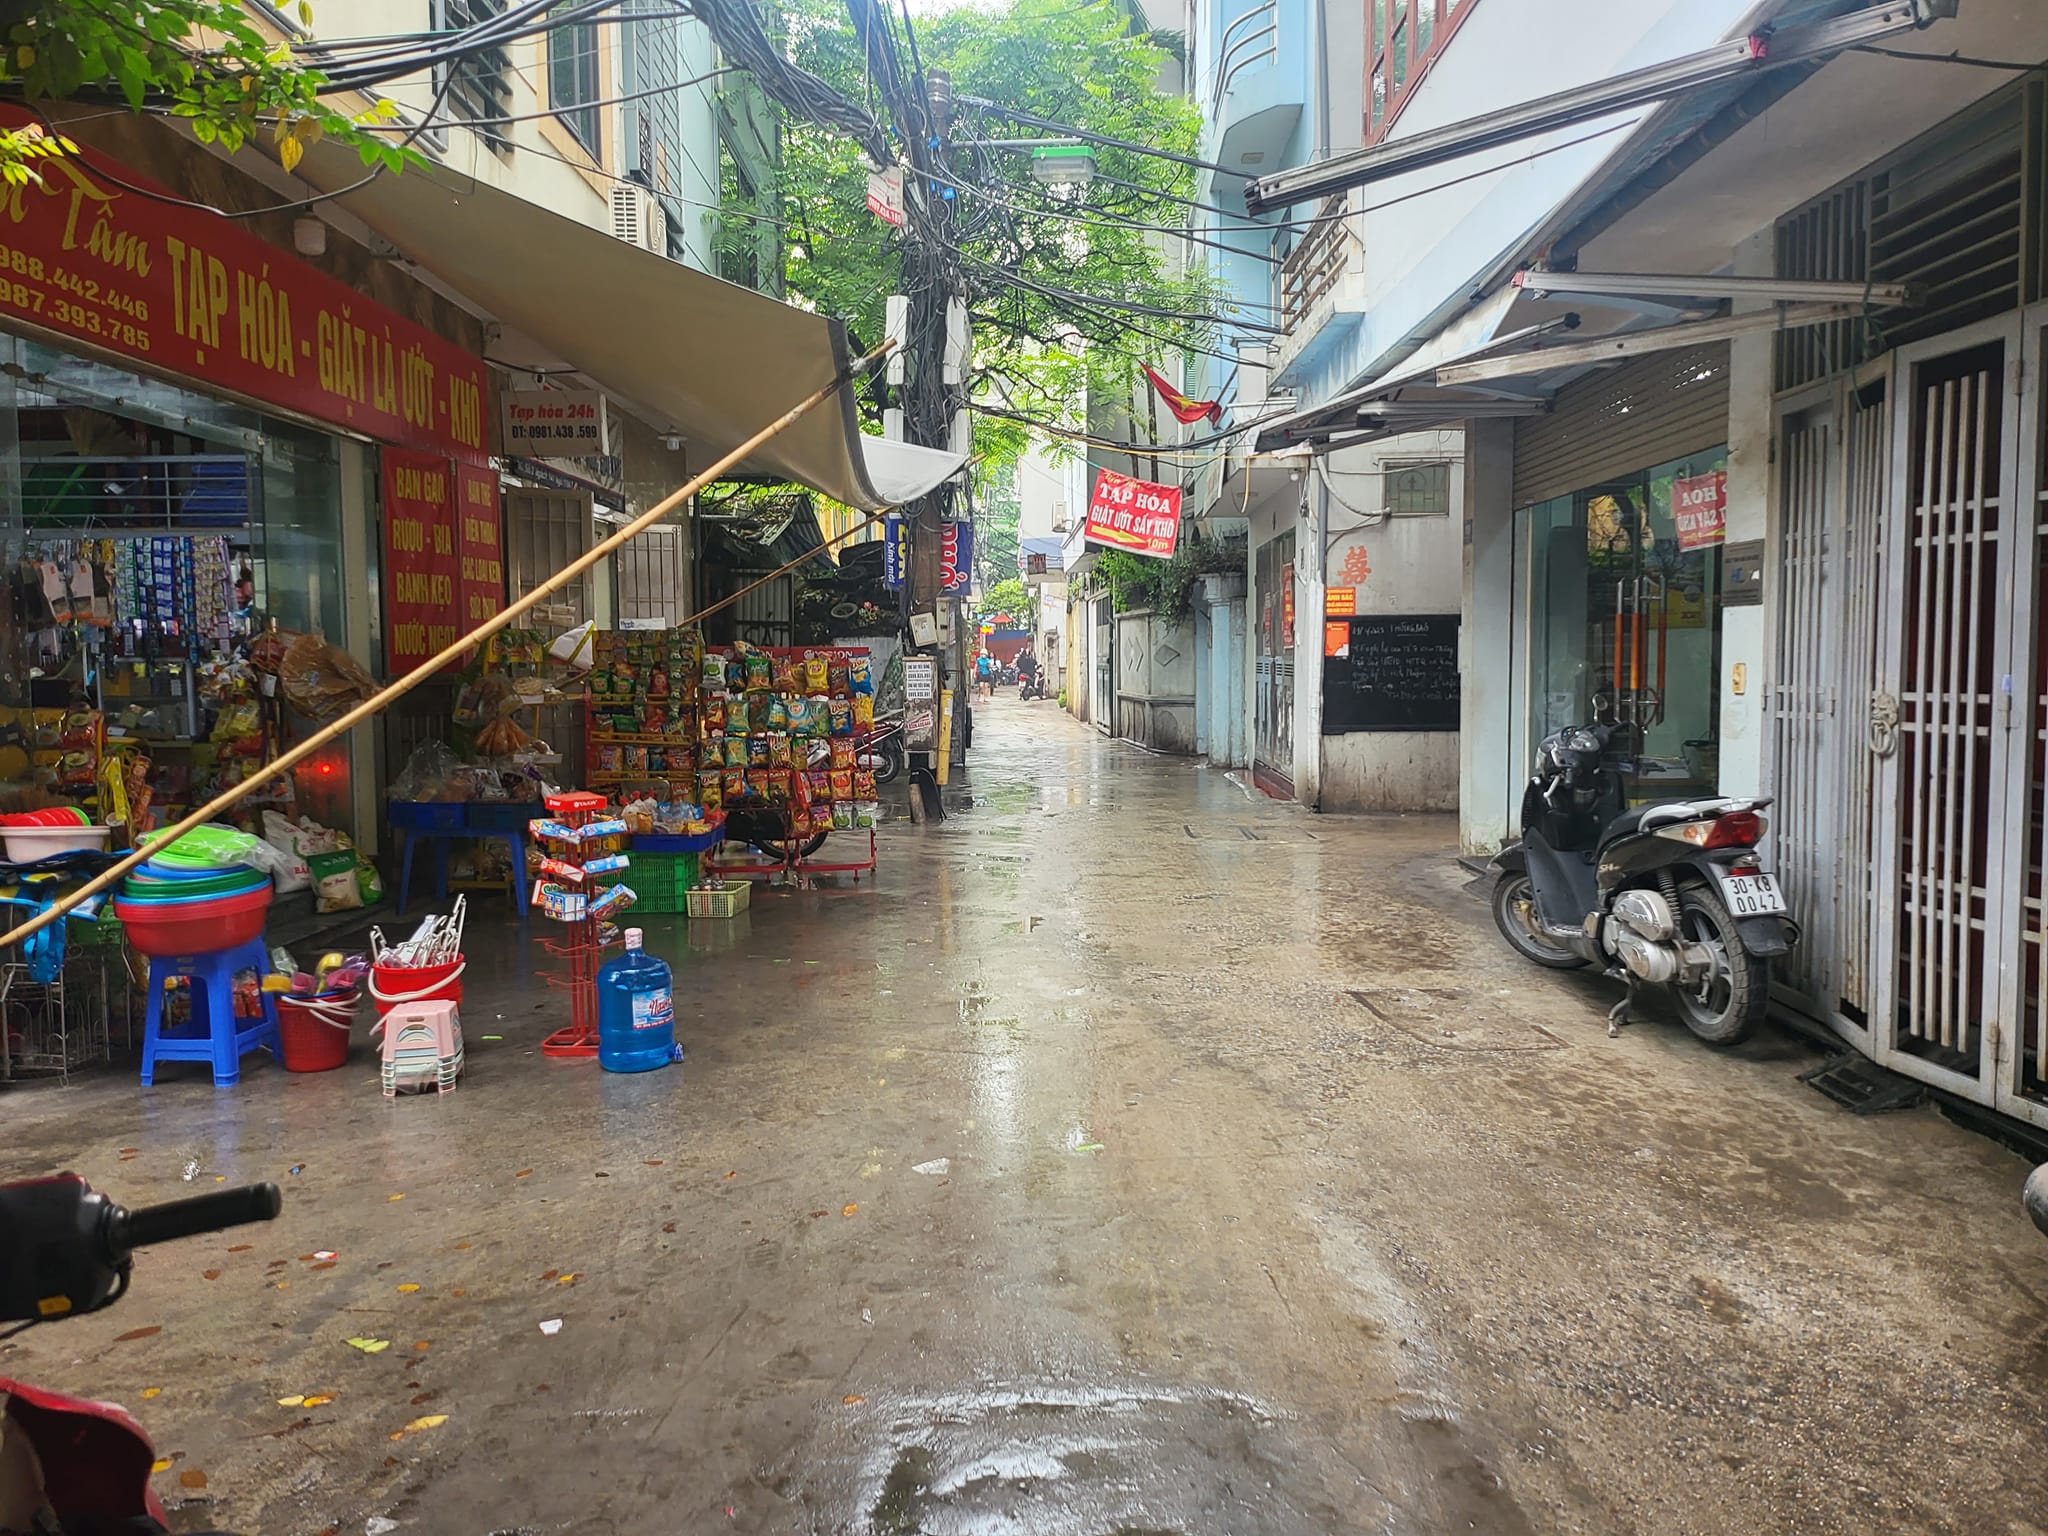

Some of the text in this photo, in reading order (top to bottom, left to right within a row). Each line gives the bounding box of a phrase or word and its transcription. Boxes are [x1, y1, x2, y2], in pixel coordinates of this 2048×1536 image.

[38, 156, 152, 277] Tâm
[167, 236, 229, 365] TẠP
[238, 263, 295, 378] HÓA
[317, 304, 368, 417] GIẶT
[371, 324, 398, 416] LÀ
[449, 371, 481, 449] KHÔ
[509, 403, 595, 422] Tạp hóa 24h
[1100, 483, 1171, 513] TẠP HÓA
[1091, 504, 1175, 538] GIẶT ƯỚT SẤY KHÔ
[433, 524, 452, 555] BIA
[1147, 538, 1168, 550] 10m
[431, 574, 452, 612] KẸO
[1730, 875, 1773, 895] 30-K8
[1736, 894, 1779, 913] 0042
